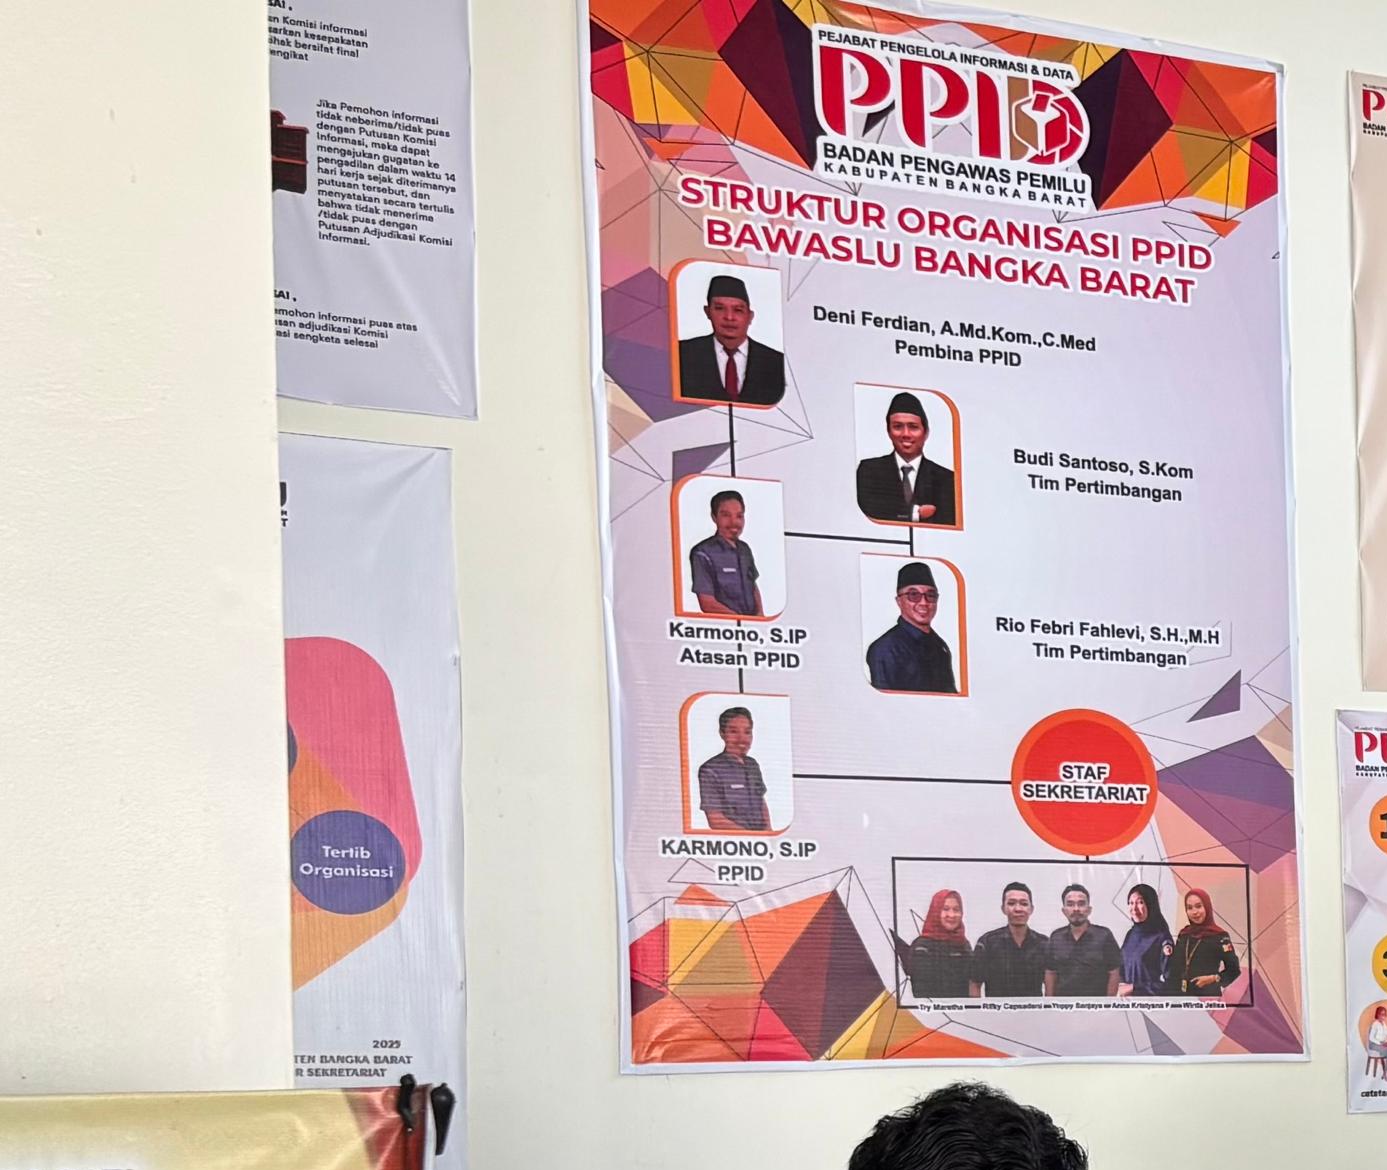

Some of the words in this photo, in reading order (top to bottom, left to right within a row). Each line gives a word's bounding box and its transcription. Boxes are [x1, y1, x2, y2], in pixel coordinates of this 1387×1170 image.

[818, 29, 877, 50] PEJABAT
[879, 39, 957, 62] PENGELOLA
[959, 52, 1027, 73] INFORMASI
[1030, 64, 1039, 75] &
[1042, 66, 1073, 81] DATA
[316, 99, 337, 109] Jika
[340, 102, 389, 116] Pemohon
[391, 110, 438, 124] informasi
[818, 45, 1088, 165] PPID
[823, 142, 893, 172] BADAN
[900, 153, 1010, 183] PENGAWAS
[1016, 169, 1089, 193] PEMILU
[681, 176, 885, 227] STRUKTUR
[897, 207, 1118, 257] ORGANISASI
[1132, 238, 1211, 269] PPID
[706, 219, 900, 267] BAWASLU
[914, 246, 1068, 287] BANGKA
[1080, 267, 1193, 301] BARAT
[813, 305, 855, 324] Deni
[861, 310, 935, 336] Ferdian,
[940, 320, 1095, 351] A.Md.Kom.,C.Med
[895, 339, 973, 361] Pembina
[979, 348, 1021, 366] PPID
[1013, 448, 1053, 466] Budi
[1058, 452, 1133, 475] Santoso,
[1138, 460, 1193, 478] S.Kom
[1027, 473, 1059, 490] Tim
[1065, 477, 1181, 502] Pertimbangan
[669, 621, 763, 643] Karmono,
[770, 627, 806, 644] S.IP
[995, 616, 1024, 632] Rio
[1030, 618, 1073, 635] Febri
[1079, 621, 1144, 642] Fahlevi,
[1150, 626, 1219, 644] S.H.,M.H
[679, 647, 747, 667] Atasan
[754, 651, 799, 668] PPID
[1032, 642, 1064, 658] Tim
[1069, 644, 1186, 667] Pertimbangan
[1062, 764, 1106, 779] STAF
[1023, 783, 1146, 801] SEKRETARIAT
[321, 845, 370, 858] Tertib
[661, 839, 773, 861] KARMONO,
[779, 841, 816, 857] S.IP
[299, 862, 393, 878] Organisasi
[716, 865, 763, 883] PPID
